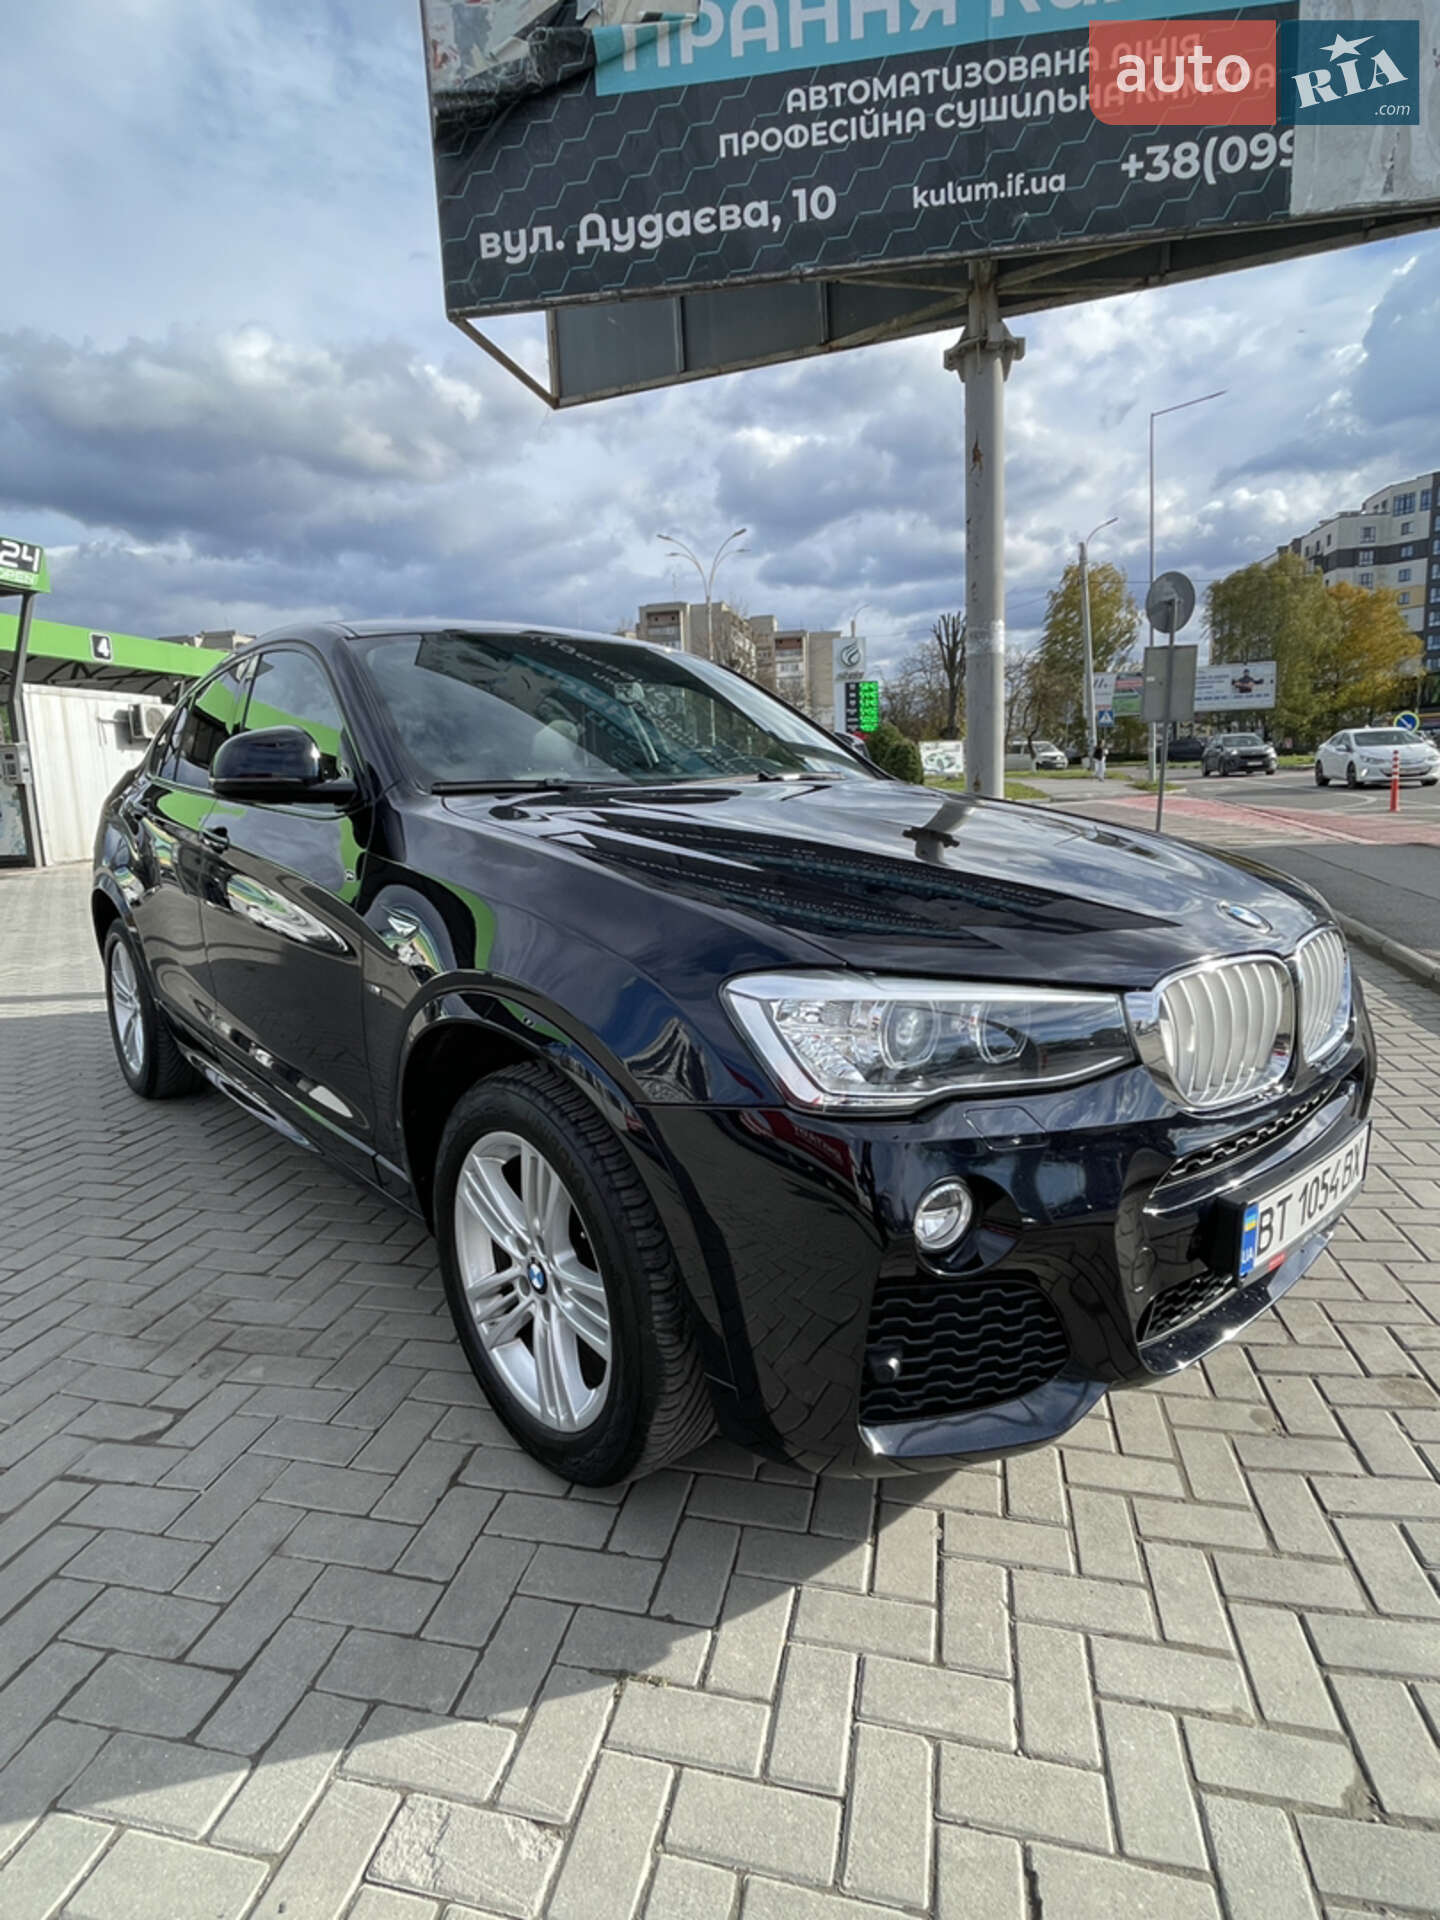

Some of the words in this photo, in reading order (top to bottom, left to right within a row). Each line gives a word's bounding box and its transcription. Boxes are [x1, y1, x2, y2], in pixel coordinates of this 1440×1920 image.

[787, 46, 1100, 114] АВТОМАТИЗОВАНА
[719, 107, 926, 158] ПРОФЕСІЙНА
[913, 173, 1066, 209] kulum.if.ua
[479, 225, 565, 264] вул.
[576, 200, 782, 255] Дудаєва,
[792, 185, 837, 224] 10
[0, 540, 40, 572] 24
[97, 637, 110, 657] 4
[1257, 1193, 1293, 1257] BT
[1299, 1159, 1341, 1226] 1054
